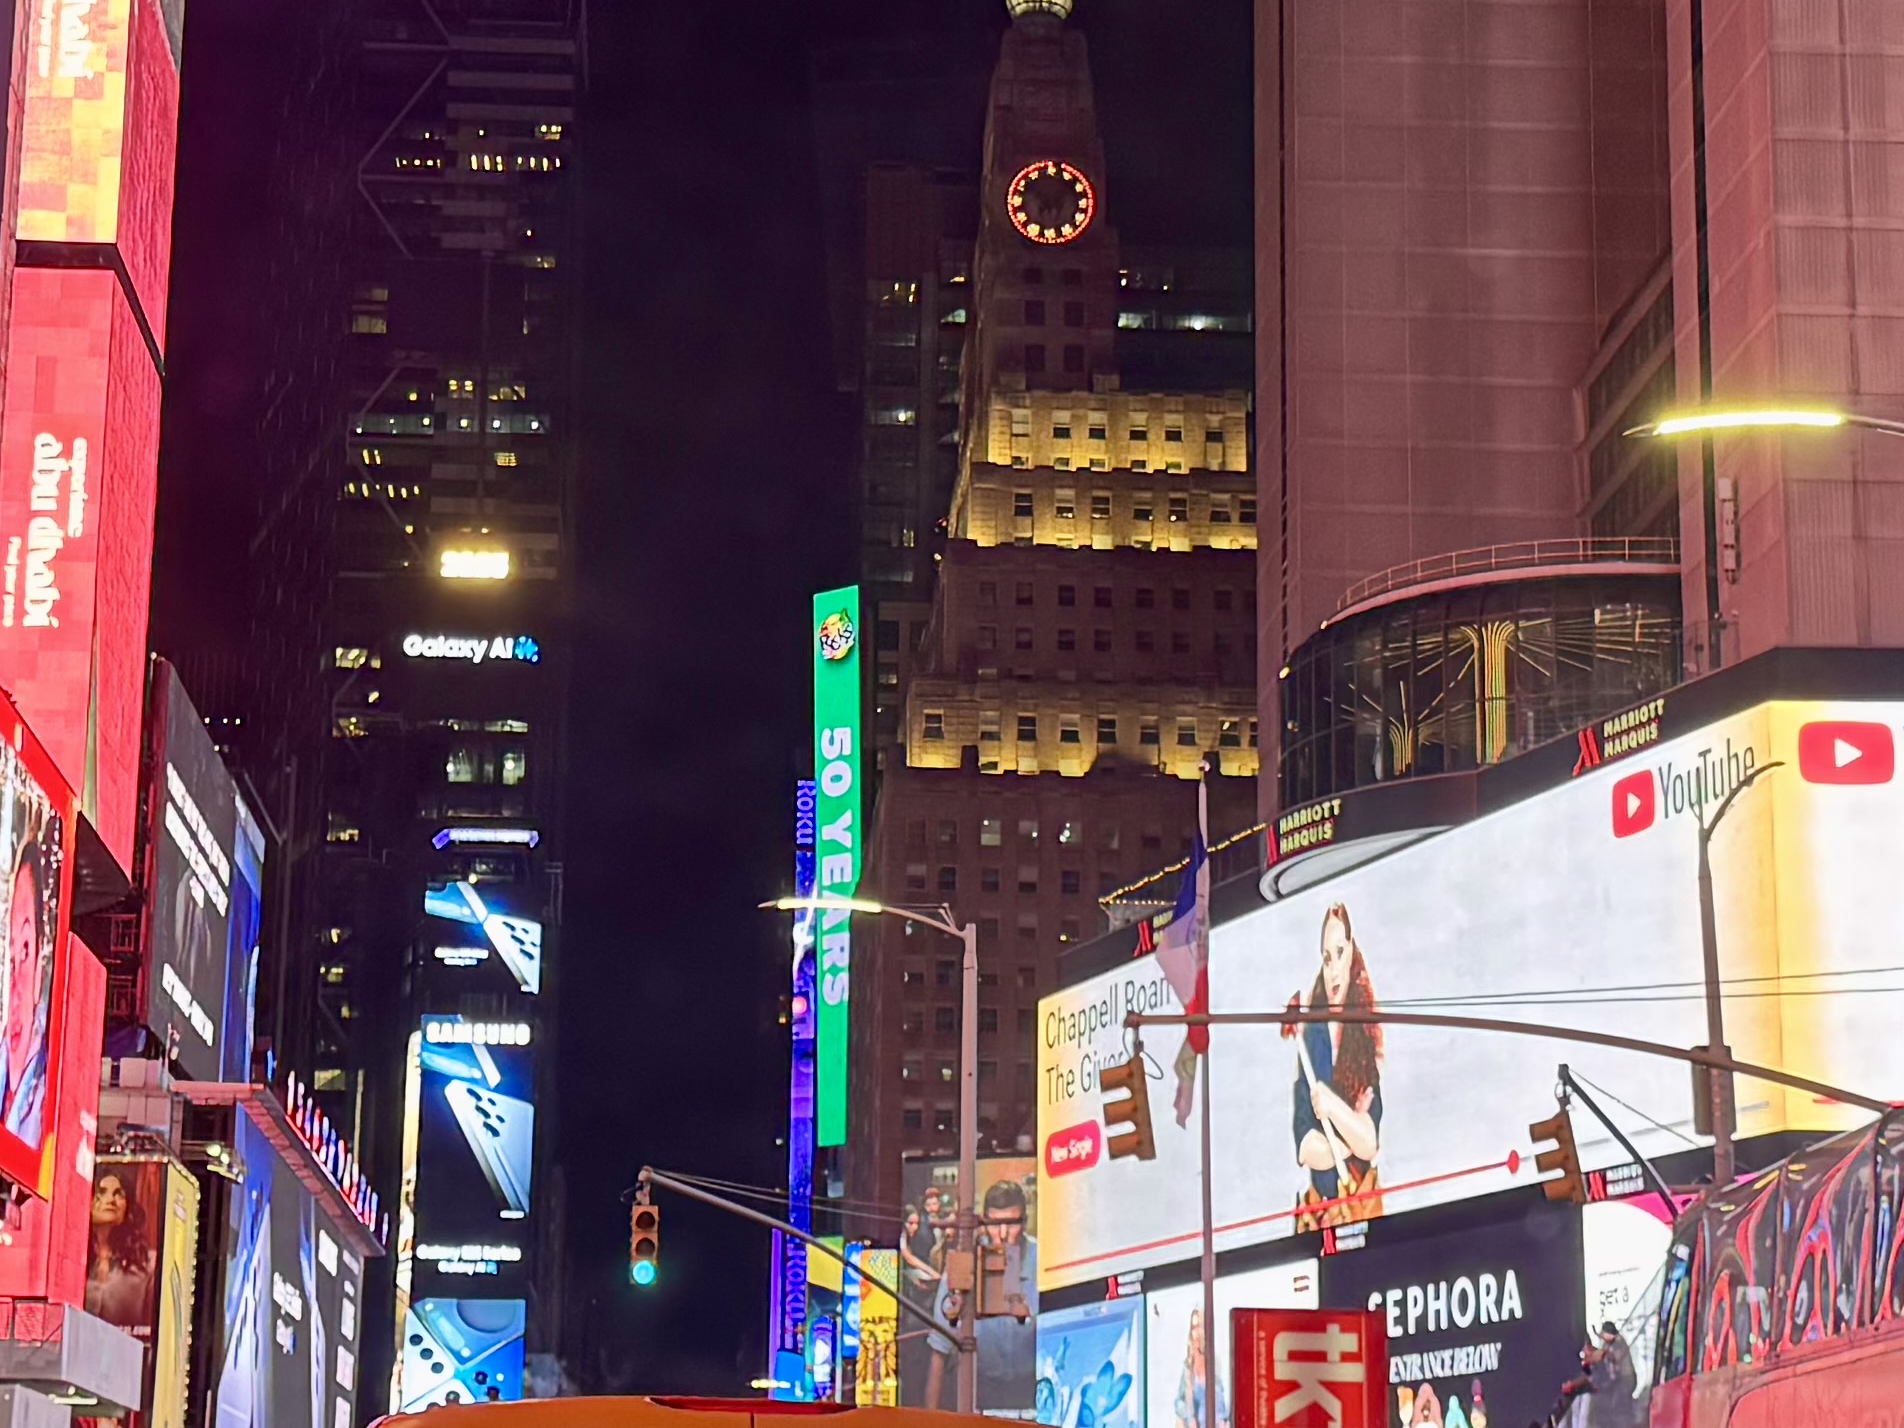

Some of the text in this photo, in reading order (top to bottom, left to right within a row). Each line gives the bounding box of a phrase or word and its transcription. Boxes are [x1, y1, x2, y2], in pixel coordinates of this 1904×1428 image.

[22, 432, 70, 629] abu dhabi
[403, 634, 489, 664] Galaxy
[1602, 698, 1666, 738] MARRIOTT
[1602, 723, 1660, 758] MARQUIS
[1278, 797, 1343, 836] MARRIOTT
[1278, 820, 1334, 855] MARQUIS
[819, 726, 854, 1008] 50 YEARS
[1045, 981, 1119, 1050] Chappell
[1044, 1064, 1076, 1106] The
